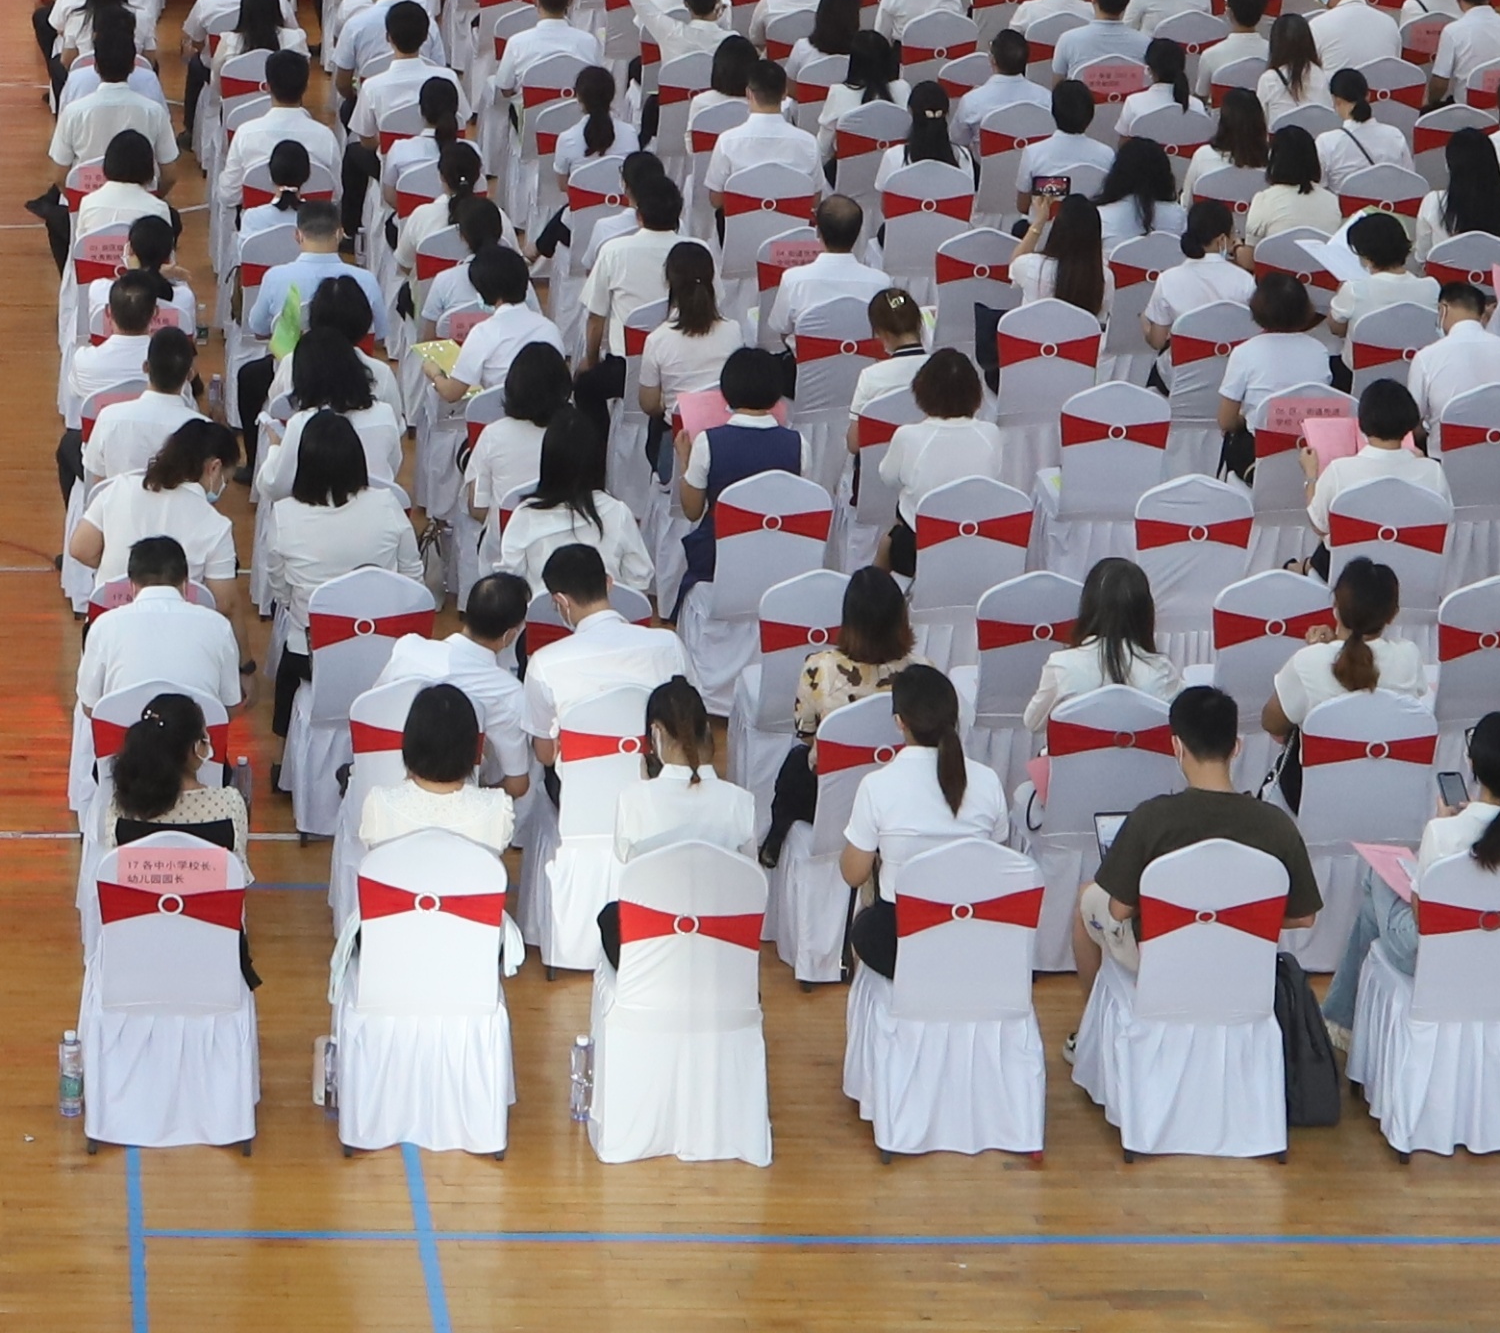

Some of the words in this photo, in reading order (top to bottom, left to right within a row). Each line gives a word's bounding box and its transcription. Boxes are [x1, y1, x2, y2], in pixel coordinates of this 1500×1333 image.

[127, 862, 139, 870] 17
[127, 874, 185, 884] 幼儿园园长
